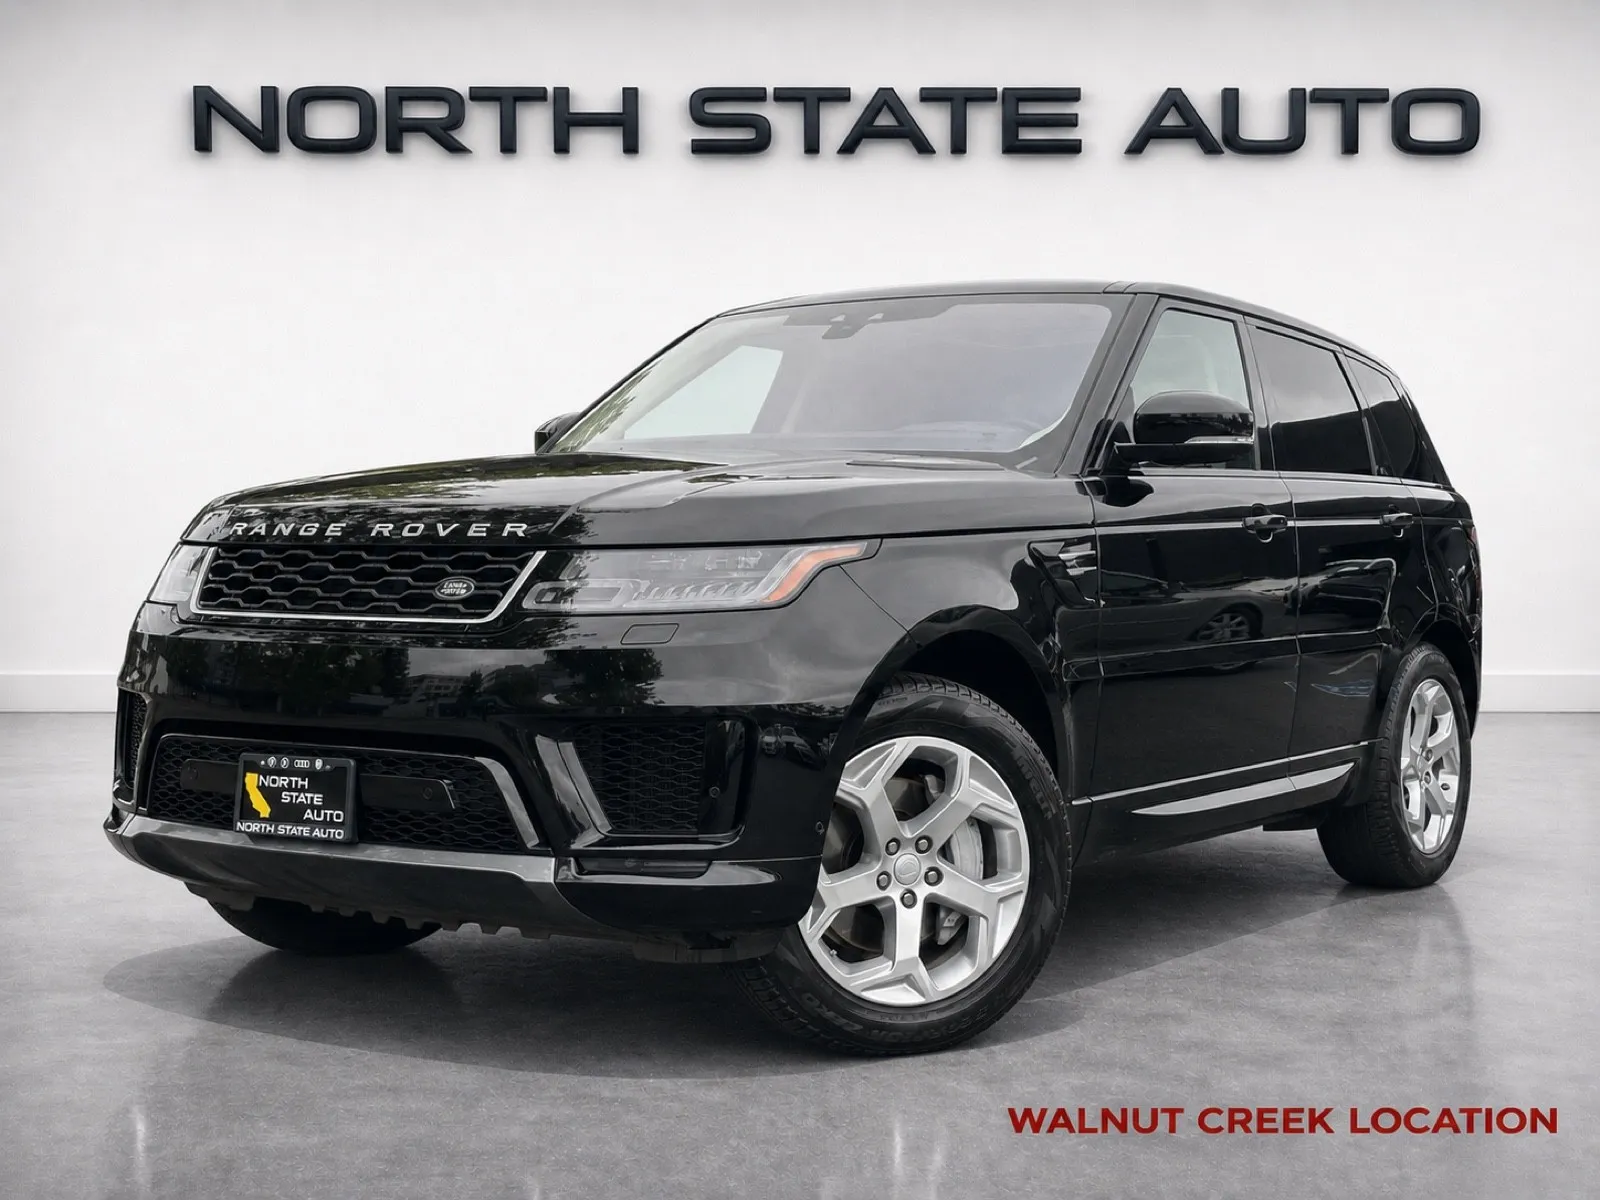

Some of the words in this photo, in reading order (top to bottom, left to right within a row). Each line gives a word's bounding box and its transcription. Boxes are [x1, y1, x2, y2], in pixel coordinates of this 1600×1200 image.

[193, 86, 639, 154] NORTH
[689, 87, 1082, 155] STATE
[1124, 88, 1480, 156] AUTO
[229, 522, 346, 537] RANGE
[370, 523, 528, 538] ROVER
[259, 774, 308, 789] NORTH
[281, 791, 323, 805] STATE
[303, 808, 344, 822] AUTO
[236, 821, 275, 833] NORTH
[277, 824, 310, 836] STATE
[312, 827, 344, 839] AUTO
